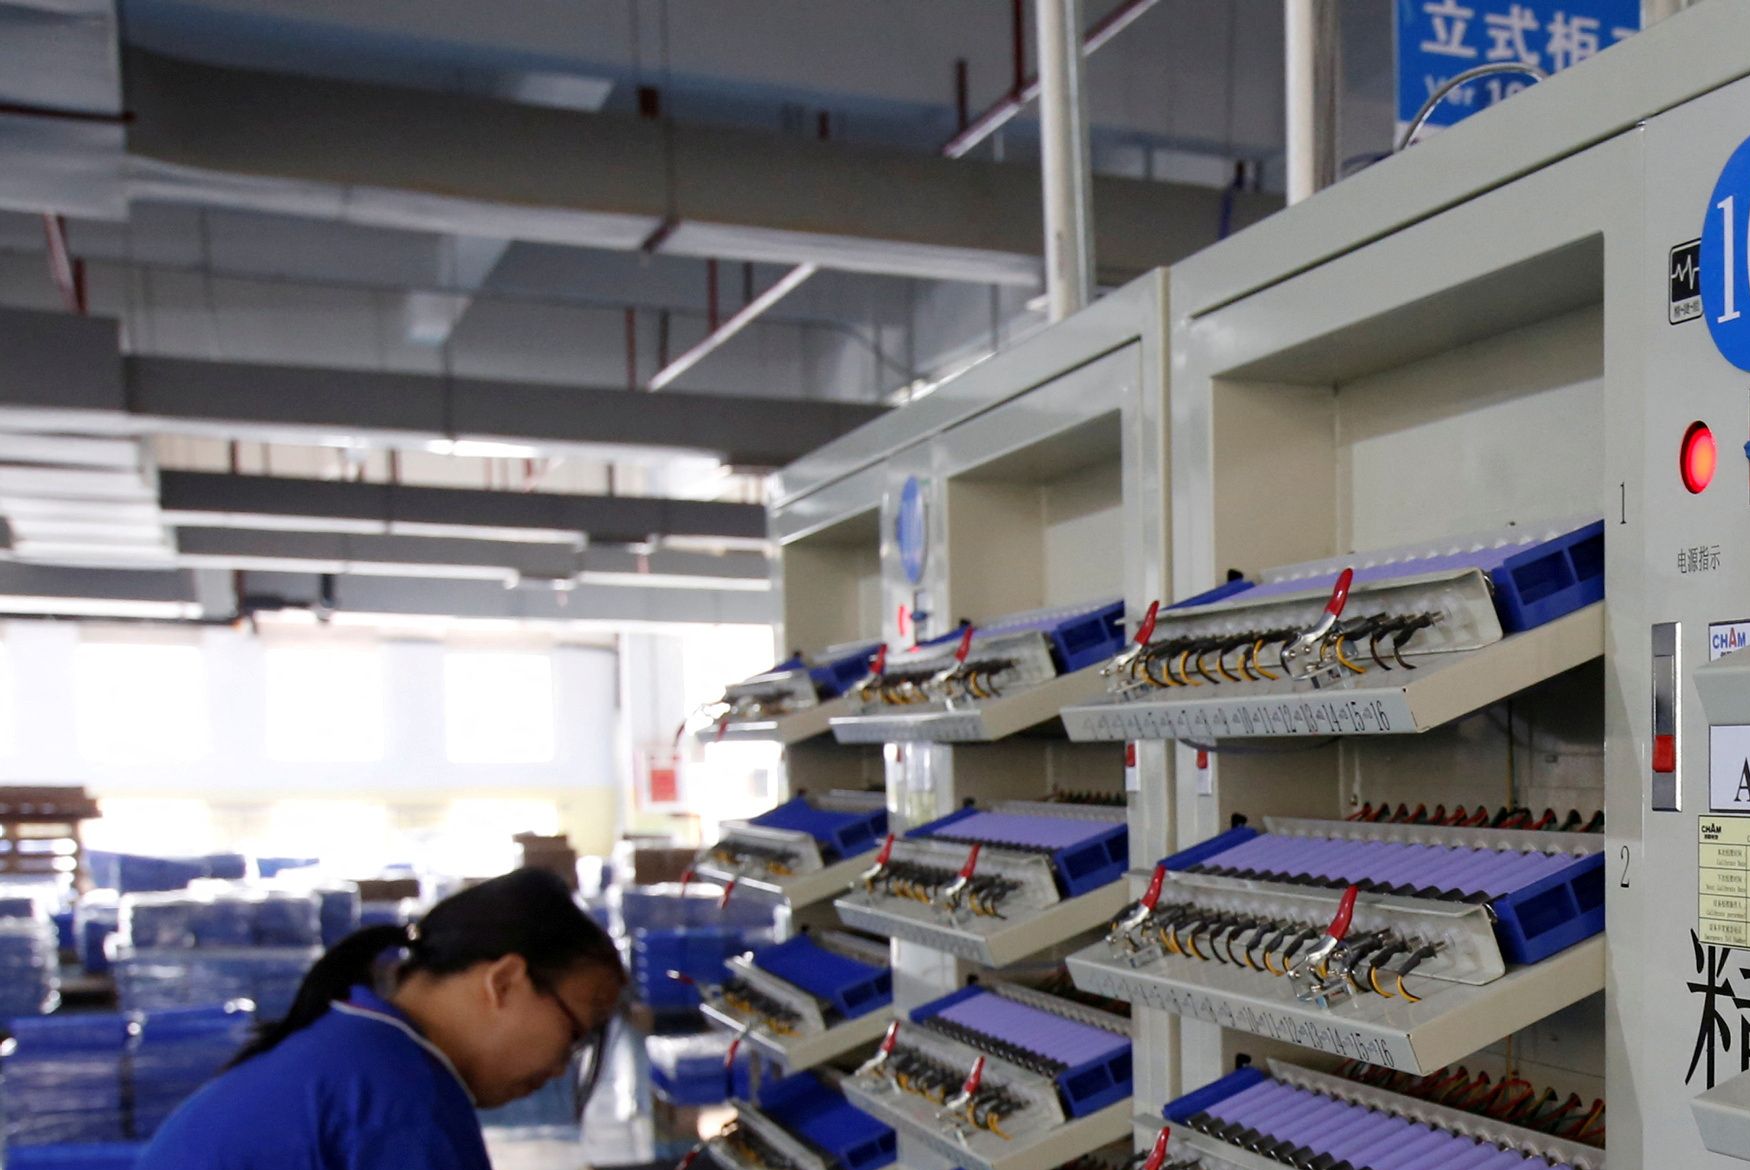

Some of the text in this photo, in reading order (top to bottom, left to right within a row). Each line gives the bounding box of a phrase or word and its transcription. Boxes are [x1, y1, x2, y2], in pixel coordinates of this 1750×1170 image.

[1420, 0, 1640, 76] 立式柜
[1618, 482, 1627, 524] 1
[1677, 544, 1720, 574] 电源指示
[1712, 627, 1746, 649] CHAM
[1257, 707, 1275, 734] 11
[1278, 705, 1297, 733] 12
[1299, 703, 1318, 733] 13
[1321, 703, 1342, 732] 14
[1345, 701, 1366, 732] 15
[1369, 700, 1391, 732] 16
[1701, 823, 1721, 834] CHAM
[1620, 845, 1630, 888] 2
[1263, 1012, 1281, 1039] 11
[1283, 1016, 1302, 1044] 12
[1304, 1021, 1323, 1049] 13
[1326, 1027, 1347, 1056] 14
[1350, 1032, 1370, 1062] 15
[1374, 1038, 1395, 1068] 16
